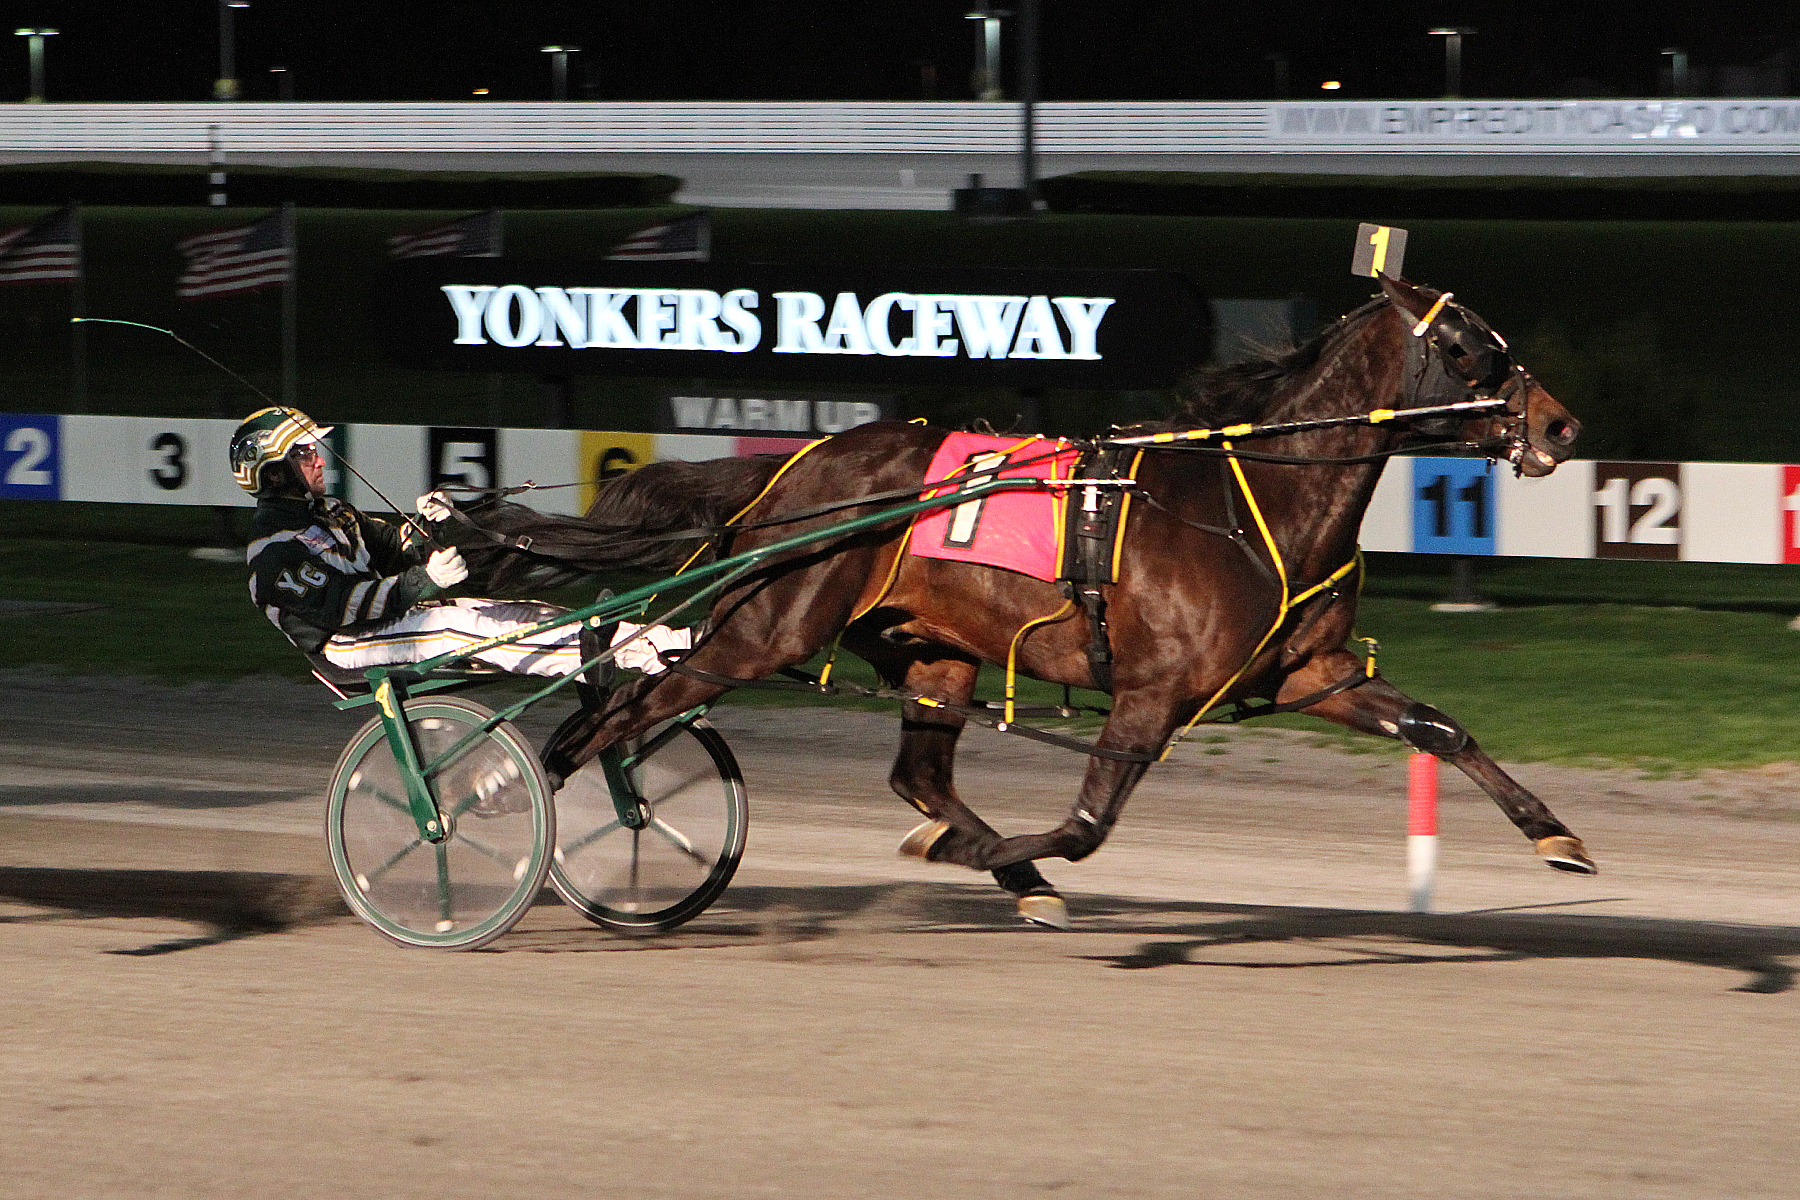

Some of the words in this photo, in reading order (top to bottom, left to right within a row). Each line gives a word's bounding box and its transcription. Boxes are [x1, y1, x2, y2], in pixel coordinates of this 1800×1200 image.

[1370, 226, 1390, 278] 1
[440, 285, 762, 353] YONKERS
[772, 292, 1116, 360] RACEWAY
[671, 397, 809, 432] WARM
[815, 401, 880, 433] UP
[6, 427, 51, 485] 2
[150, 432, 188, 490] 3
[441, 442, 490, 502] 5
[944, 450, 1012, 549] 1
[1418, 475, 1487, 538] 11
[1594, 477, 1681, 544] 12
[275, 562, 329, 597] YG
